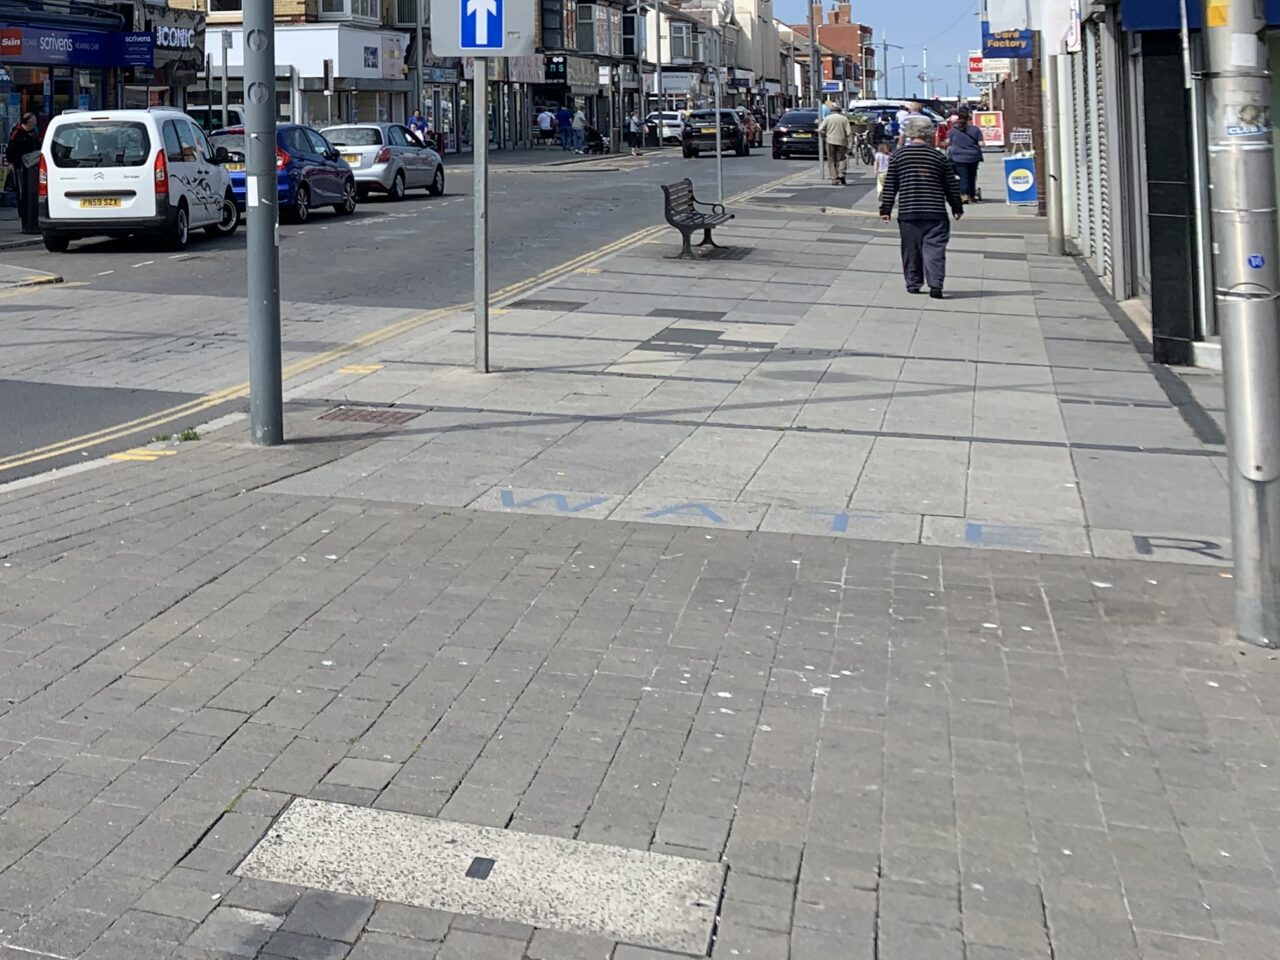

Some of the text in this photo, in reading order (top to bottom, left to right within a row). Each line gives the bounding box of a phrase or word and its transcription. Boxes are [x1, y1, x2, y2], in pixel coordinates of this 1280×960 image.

[40, 33, 73, 52] scrivens
[125, 34, 151, 43] scrivens
[157, 25, 195, 49] ICONIC
[988, 40, 1027, 48] Factory
